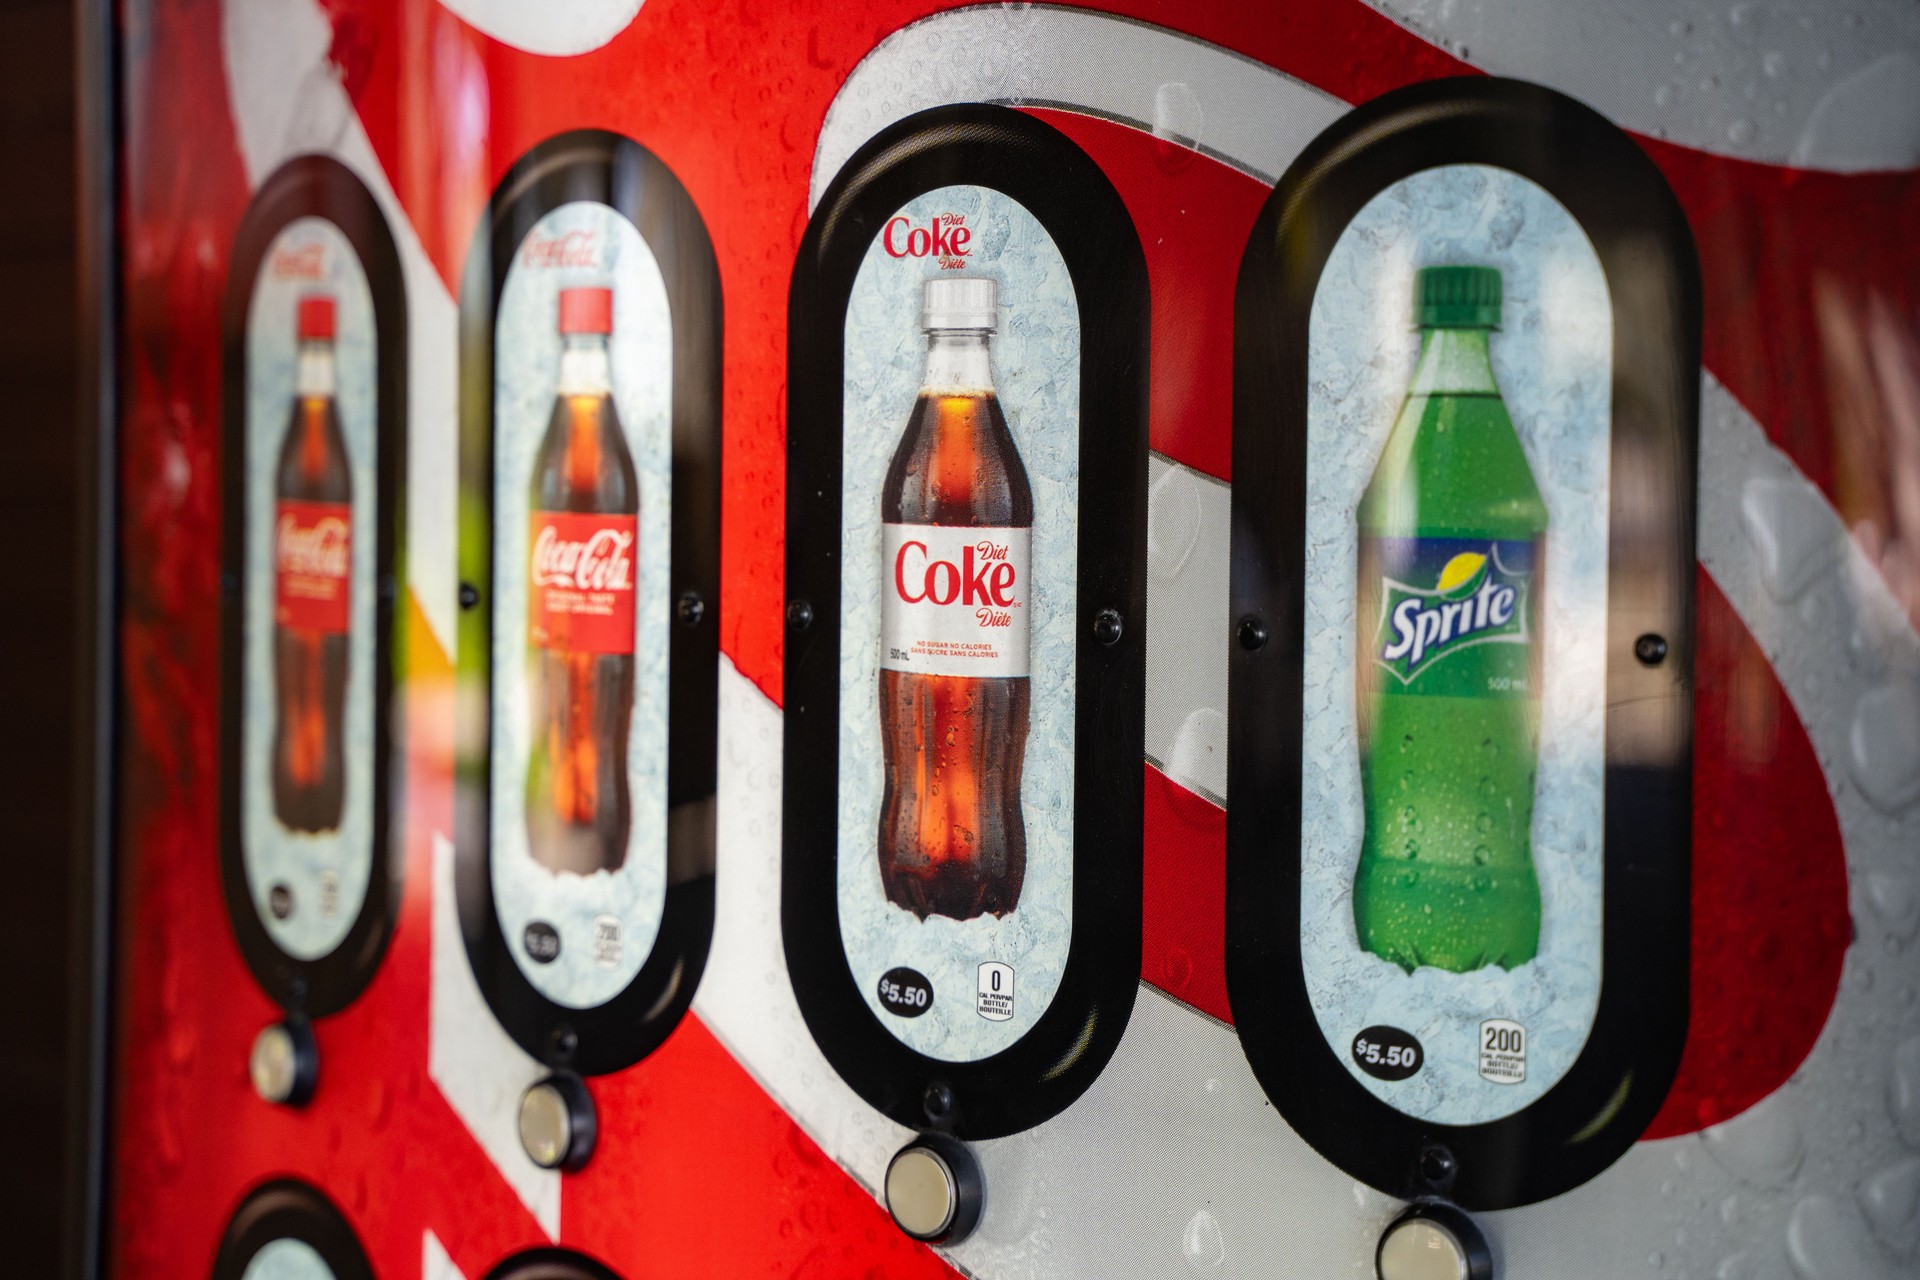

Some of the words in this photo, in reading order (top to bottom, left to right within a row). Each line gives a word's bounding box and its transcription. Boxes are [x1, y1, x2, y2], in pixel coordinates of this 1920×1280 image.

[941, 212, 965, 226] Diet
[883, 216, 971, 258] Coke
[977, 541, 1008, 560] Diet
[895, 541, 1015, 607] Coke
[976, 607, 1011, 627] Diète
[1384, 573, 1517, 669] Sprite
[927, 641, 948, 649] SUGAR
[961, 643, 992, 651] CALORIES
[927, 648, 948, 656] SUCRE
[950, 649, 966, 657] SANS
[968, 650, 998, 658] CALORIES
[1487, 676, 1511, 691] 500
[992, 970, 1001, 992] 0
[880, 978, 927, 1007] $5.50
[979, 1005, 1012, 1016] BOUTEILLE
[1485, 1027, 1522, 1053] 200
[1356, 1038, 1416, 1069] $5.50
